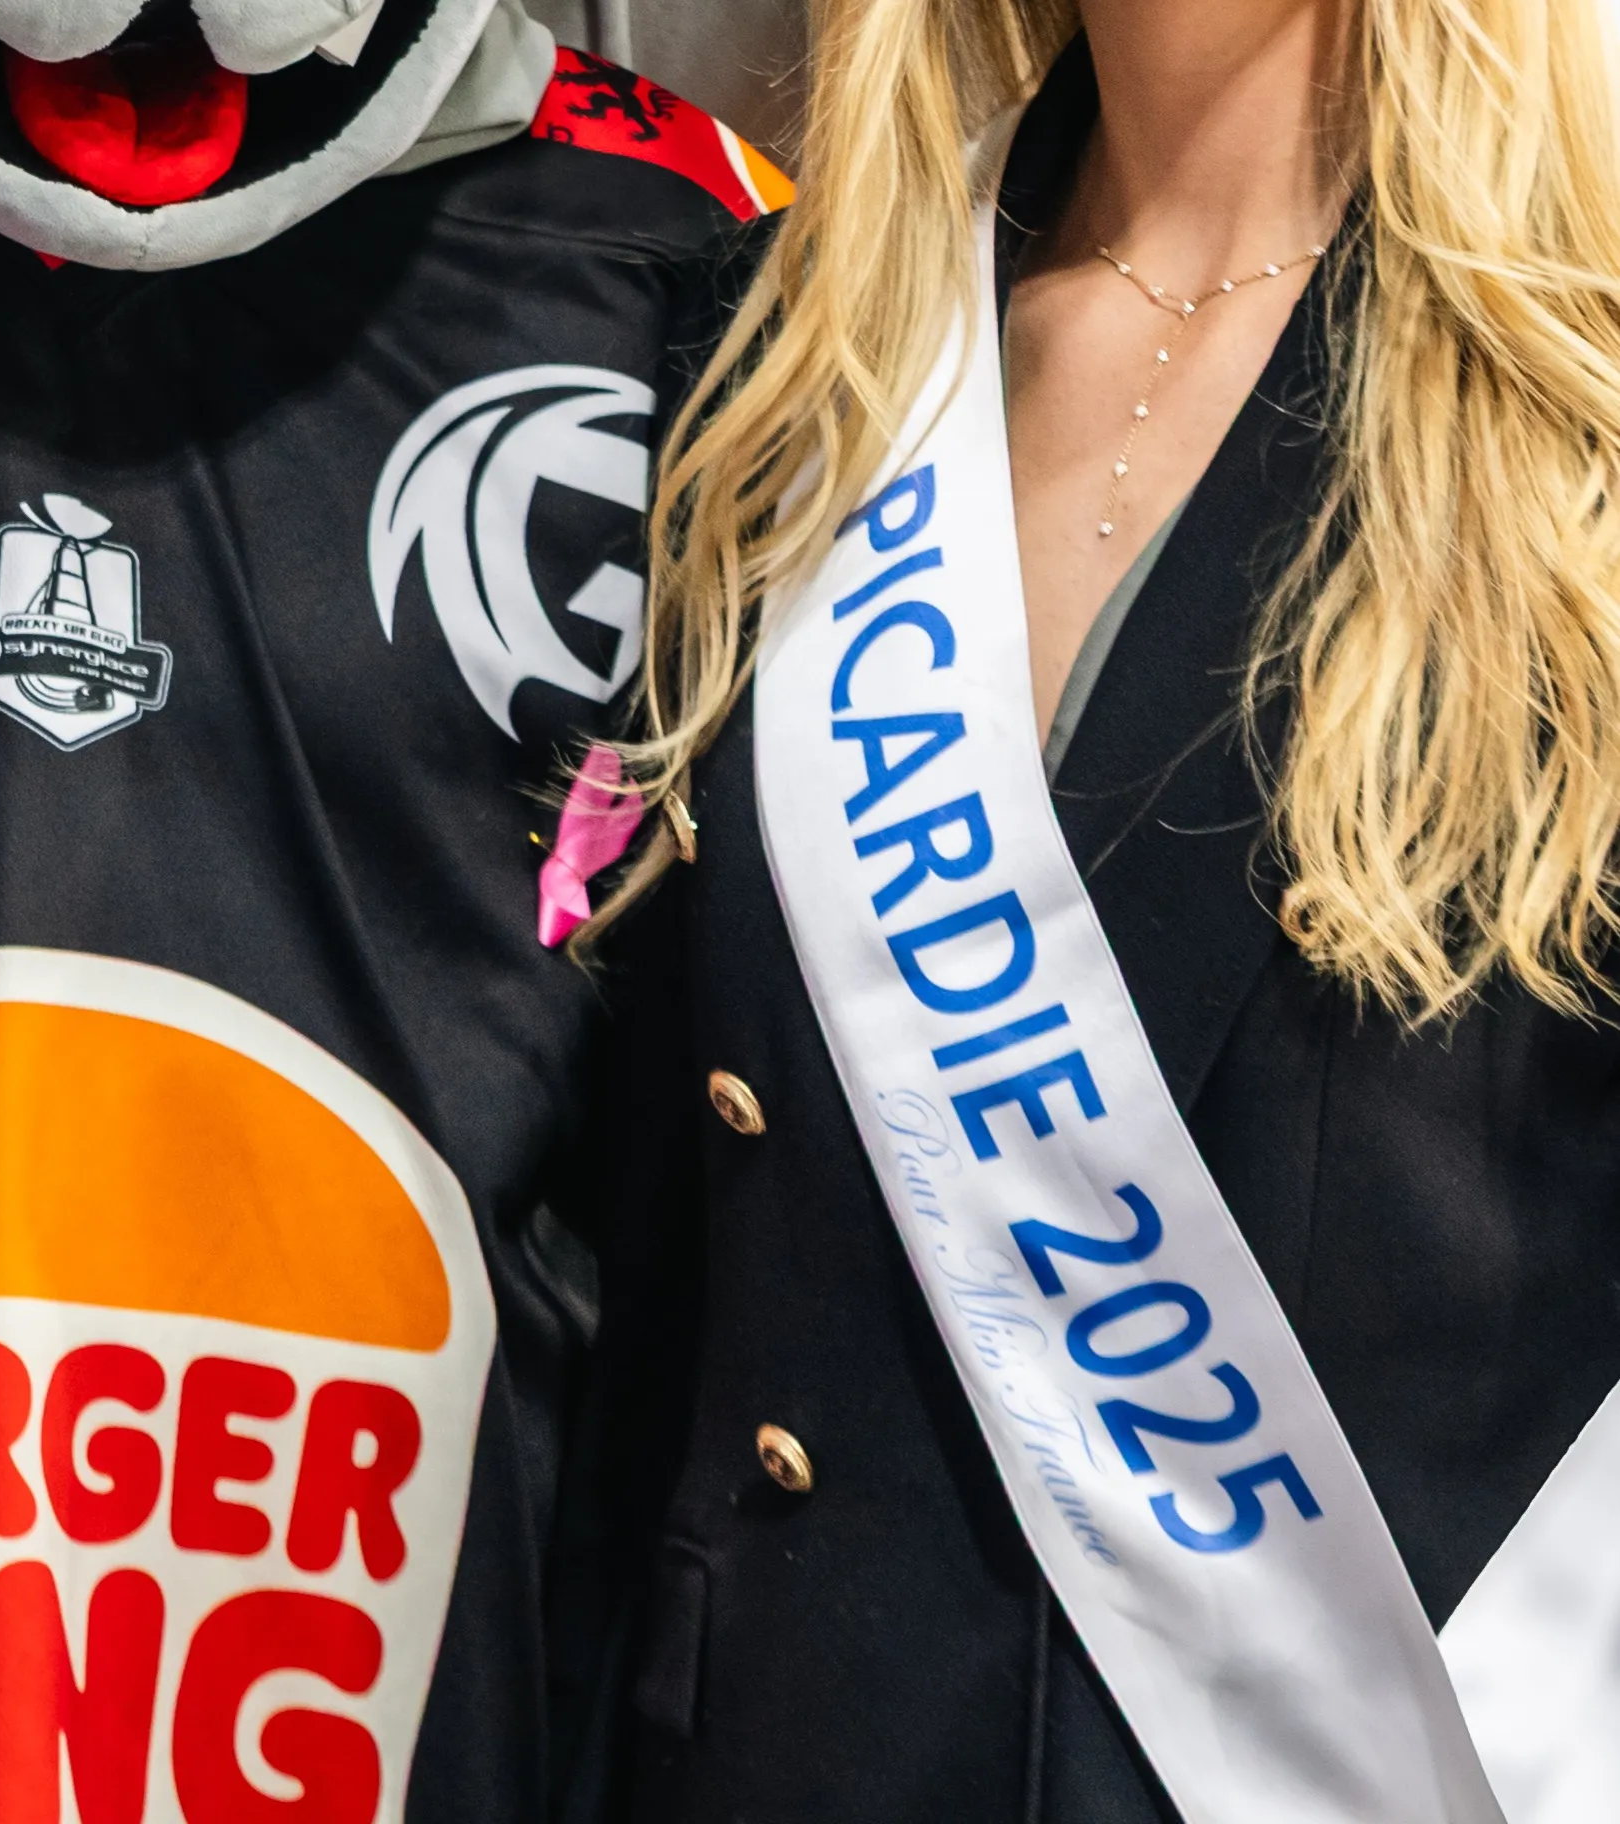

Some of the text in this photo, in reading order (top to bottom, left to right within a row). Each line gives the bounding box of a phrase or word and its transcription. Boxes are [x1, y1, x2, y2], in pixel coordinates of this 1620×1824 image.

[3, 640, 150, 677] synerglace
[4, 617, 59, 631] HOCKEY
[64, 622, 87, 636] SUR
[830, 462, 1325, 1557] PICARDIE 2025
[876, 1087, 962, 1228] Pour
[1001, 1383, 1121, 1569] France
